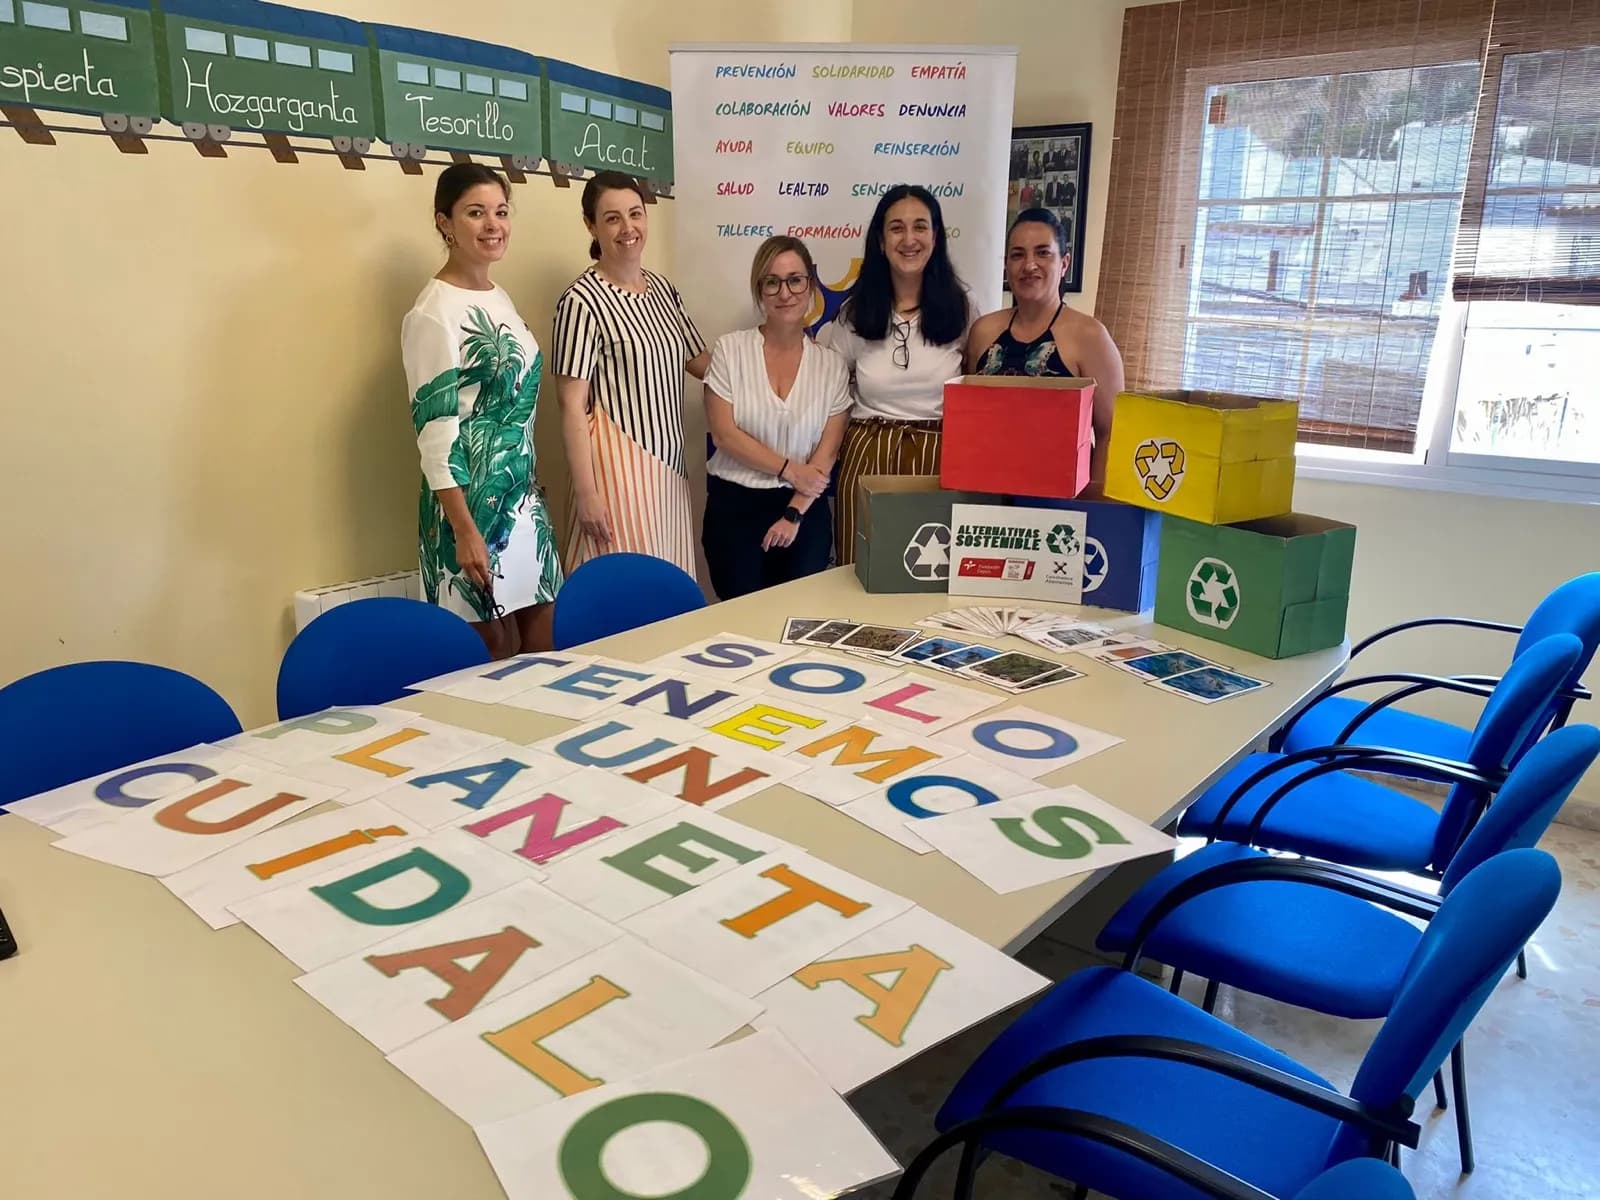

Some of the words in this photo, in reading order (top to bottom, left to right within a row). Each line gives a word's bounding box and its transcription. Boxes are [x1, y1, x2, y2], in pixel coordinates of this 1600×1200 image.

[715, 63, 797, 78] PREVENCIÓN
[812, 65, 895, 78] SOLIDARIDAD
[911, 61, 967, 79] EMPATÍA
[182, 57, 359, 131] Hozgarganta
[405, 93, 514, 141] Tesorillo
[715, 99, 811, 116] COLABORACIÓN
[828, 101, 885, 117] VALORES
[899, 103, 967, 117] DENUNCIA
[715, 139, 752, 153] AYUDA
[786, 141, 834, 154] EQUIPO
[873, 140, 960, 156] REINSERCIÓN
[716, 181, 755, 196] SALUD
[778, 181, 829, 197] LEALTAD
[716, 223, 774, 238] TALLERES
[787, 223, 863, 239] FORMACIÓN
[957, 524, 1040, 539] ALTERNATIVAS
[955, 534, 1042, 552] SOSTENIBLE
[687, 642, 1081, 759] SOLO
[551, 721, 771, 808] UN
[250, 704, 954, 1047] PLANETA
[93, 761, 754, 1200] CUÍDALO
